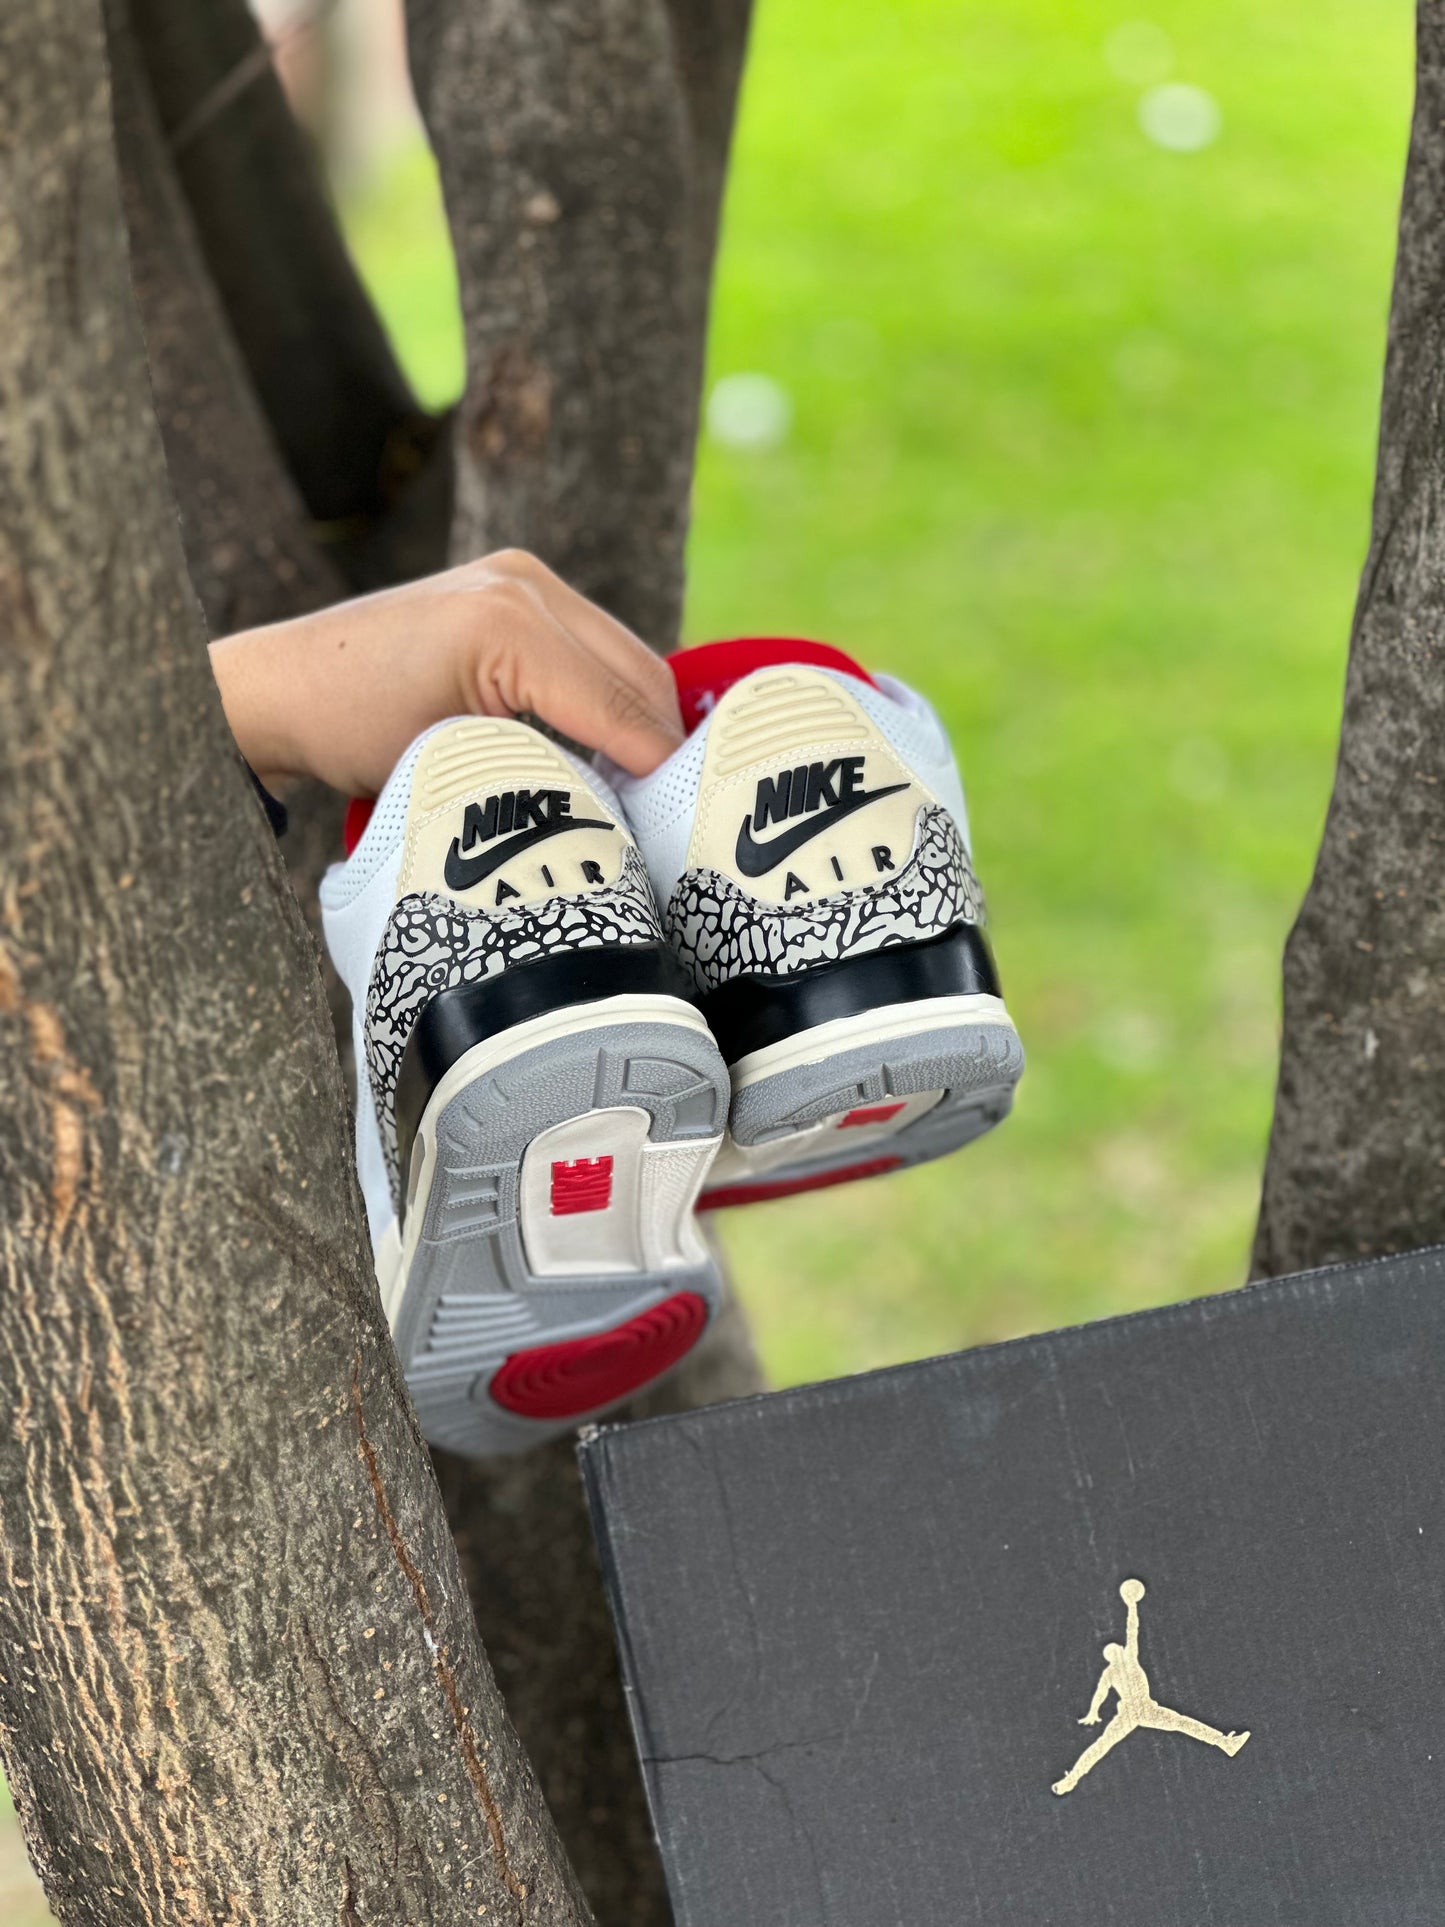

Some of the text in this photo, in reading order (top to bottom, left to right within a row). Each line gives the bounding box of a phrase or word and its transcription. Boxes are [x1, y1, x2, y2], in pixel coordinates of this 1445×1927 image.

[462, 789, 573, 852] NIKE
[753, 756, 866, 832] NIKE
[495, 861, 604, 906] AIR
[785, 845, 895, 901] AIR
